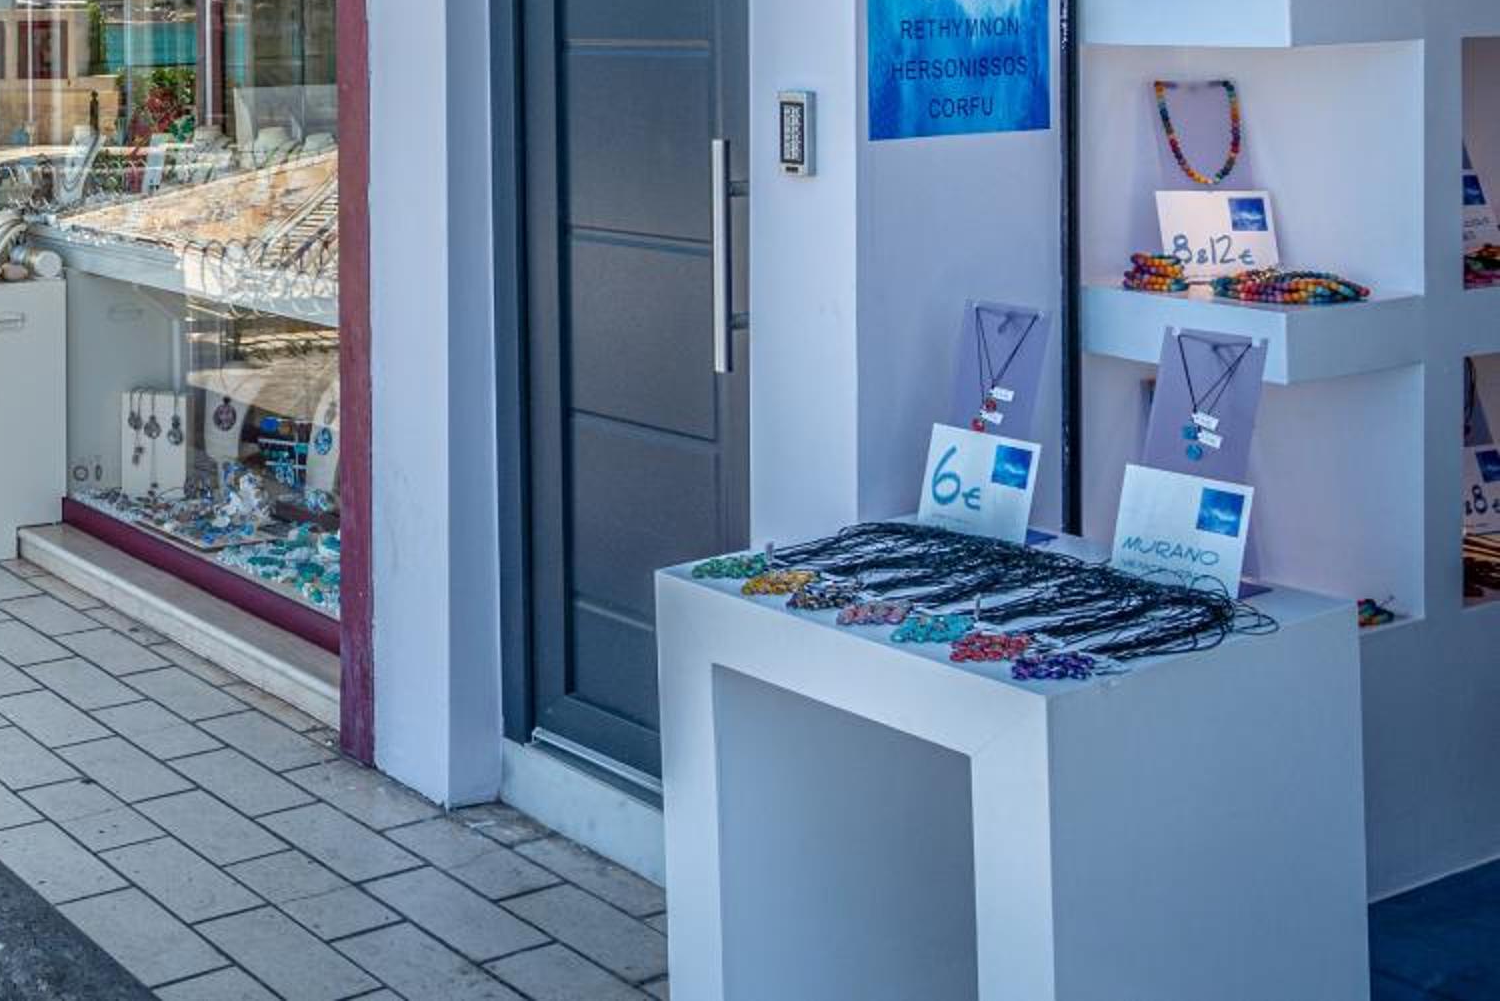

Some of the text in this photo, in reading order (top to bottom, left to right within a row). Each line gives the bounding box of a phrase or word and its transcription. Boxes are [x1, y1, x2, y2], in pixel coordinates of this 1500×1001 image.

[900, 17, 1019, 40] RETHYMNON
[891, 55, 1028, 81] HERSONISSOS
[928, 96, 994, 120] CORFU
[1122, 536, 1220, 566] MURANO
